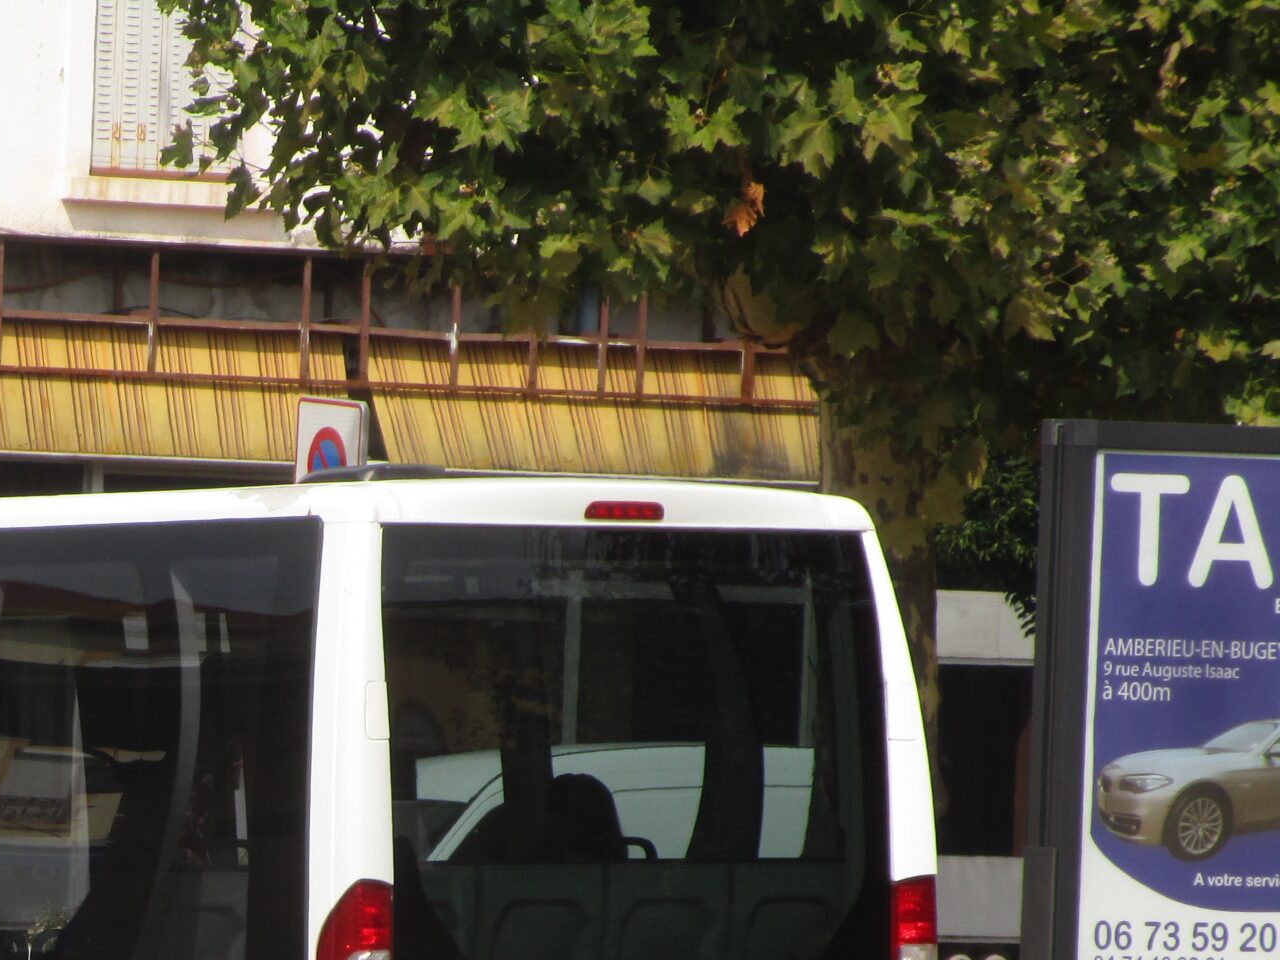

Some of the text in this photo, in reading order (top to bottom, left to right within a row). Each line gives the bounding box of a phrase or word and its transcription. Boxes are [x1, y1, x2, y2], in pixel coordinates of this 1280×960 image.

[1111, 472, 1274, 589] TA
[1104, 638, 1280, 660] AMBERIEU-EN-BUGE
[1103, 661, 1240, 681] 9 rue Auguste Isaac
[1102, 680, 1171, 702] à 400m
[1193, 872, 1205, 886] A
[1208, 874, 1242, 887] votre
[1094, 920, 1277, 952] 06 73 59 20
